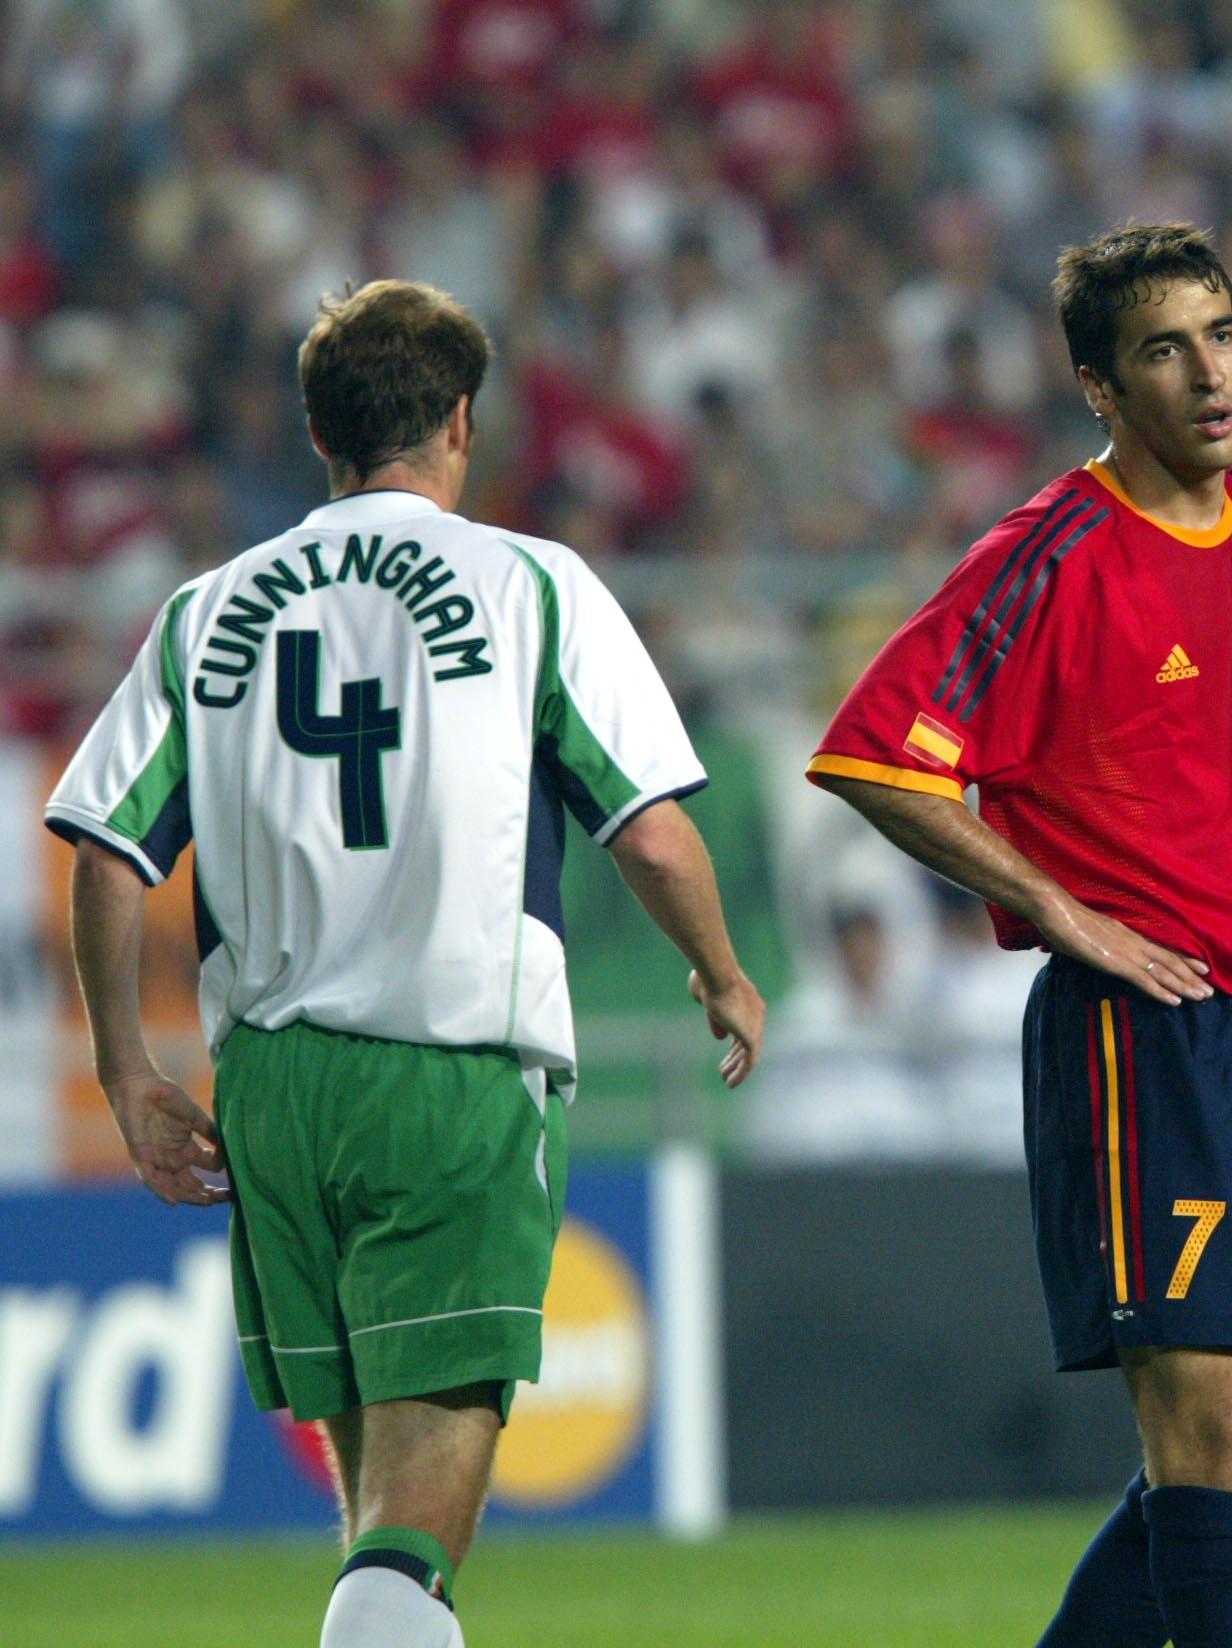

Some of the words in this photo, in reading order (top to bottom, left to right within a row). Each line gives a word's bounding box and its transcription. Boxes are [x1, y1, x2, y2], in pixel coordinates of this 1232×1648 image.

[193, 533, 493, 709] CUNNINGHAM
[1156, 665, 1200, 684] adidas
[276, 629, 401, 851] 4
[1165, 1199, 1227, 1299] 7
